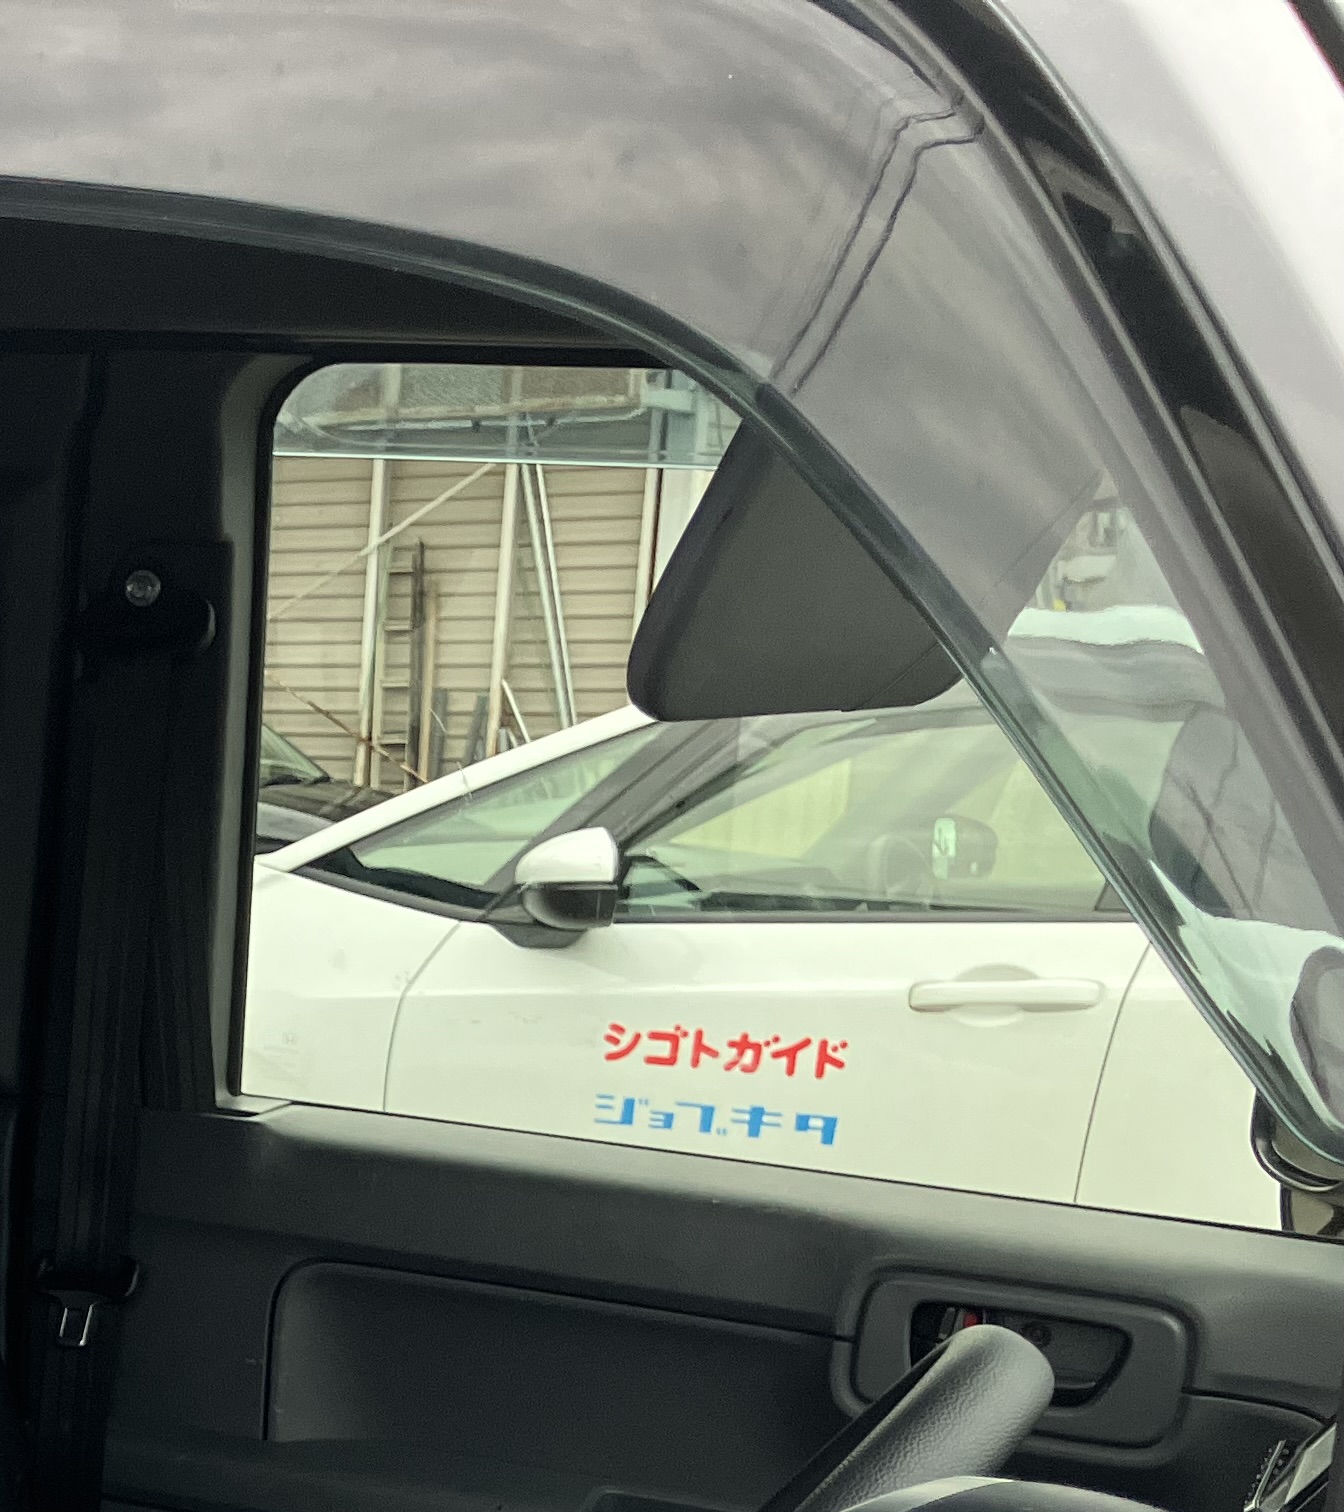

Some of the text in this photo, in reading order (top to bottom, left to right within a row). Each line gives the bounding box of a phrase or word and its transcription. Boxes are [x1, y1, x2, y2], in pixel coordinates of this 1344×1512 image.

[603, 1022, 849, 1080] シゴトガイド
[594, 1093, 839, 1146] ジョブキタ
